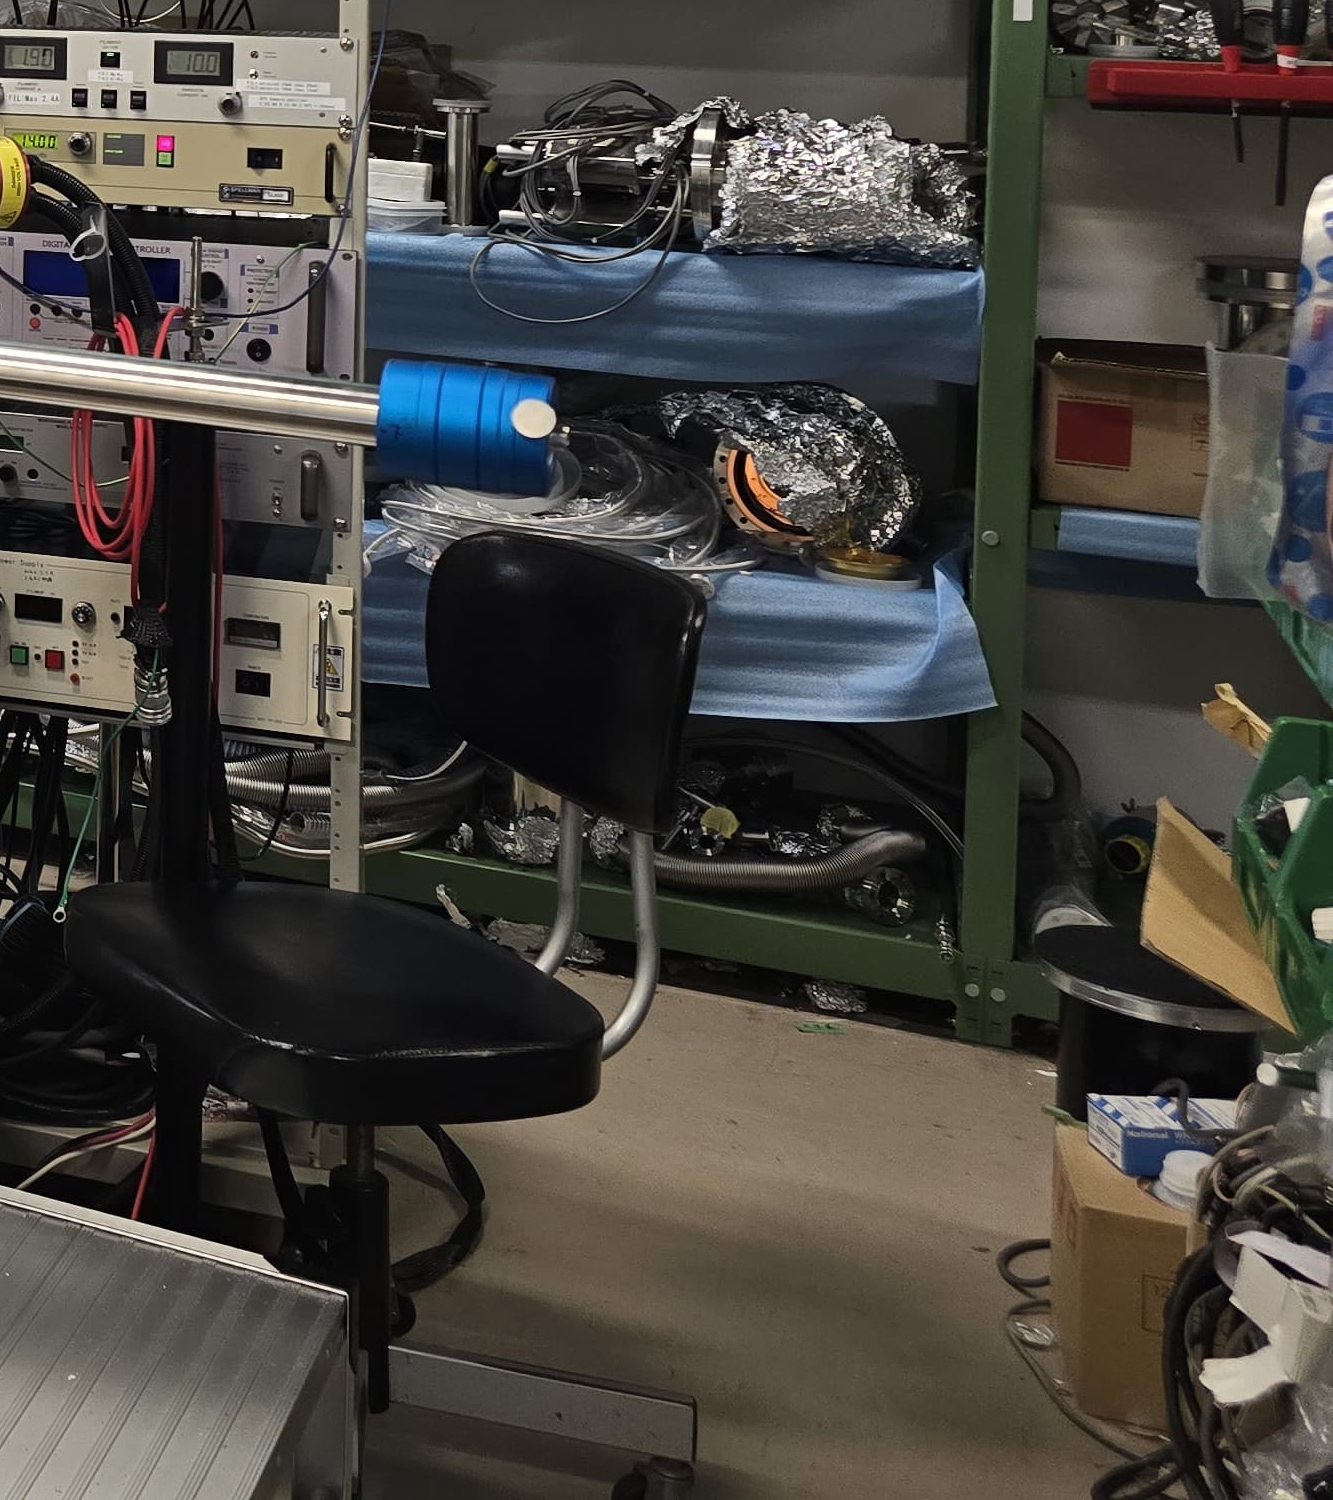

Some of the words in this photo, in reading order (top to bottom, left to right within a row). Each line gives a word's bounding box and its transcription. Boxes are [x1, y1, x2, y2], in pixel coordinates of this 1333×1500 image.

[231, 186, 262, 194] SPELLMAN
[42, 240, 71, 249] DIGITA
[20, 559, 44, 568] Supply
[1126, 1130, 1169, 1140] National
